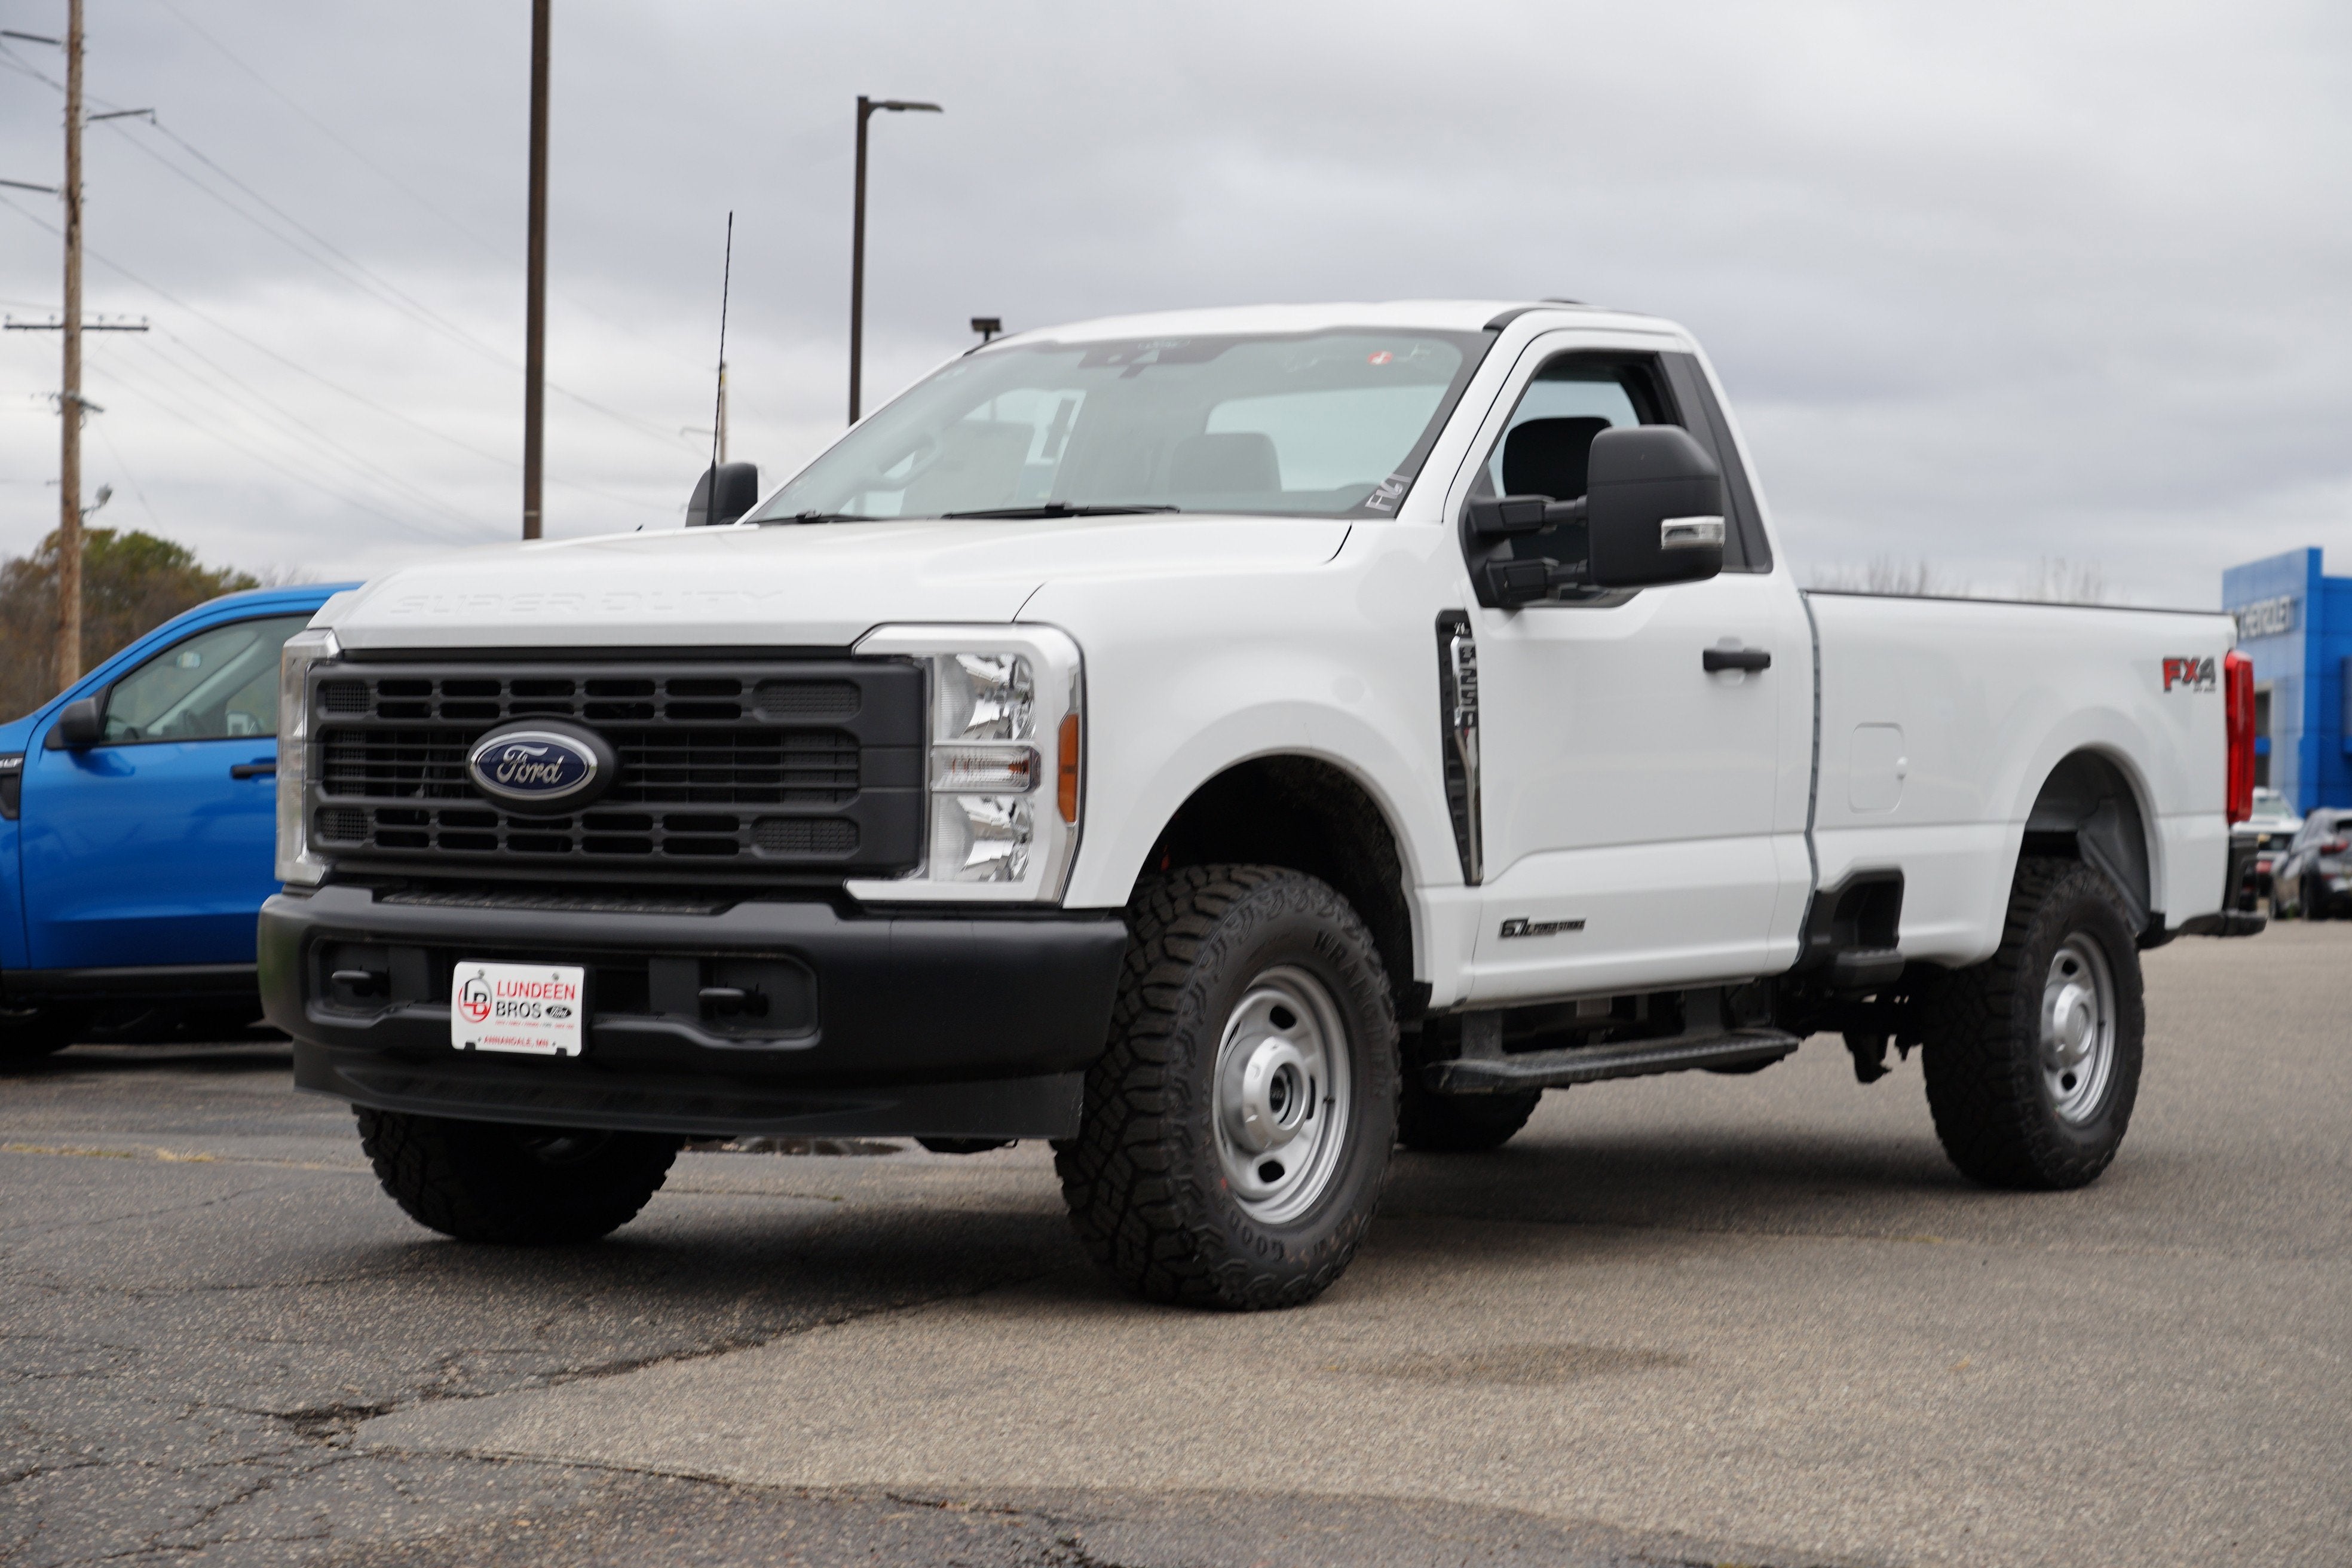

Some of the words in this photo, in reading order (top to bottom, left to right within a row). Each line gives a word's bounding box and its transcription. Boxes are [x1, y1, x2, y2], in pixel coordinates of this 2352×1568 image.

[388, 592, 586, 617] SUPER
[599, 589, 784, 615] DUTY
[2162, 657, 2216, 693] FX4
[496, 745, 565, 784] Ford
[497, 979, 576, 1000] LUNDEEN
[495, 1001, 541, 1019] BROS
